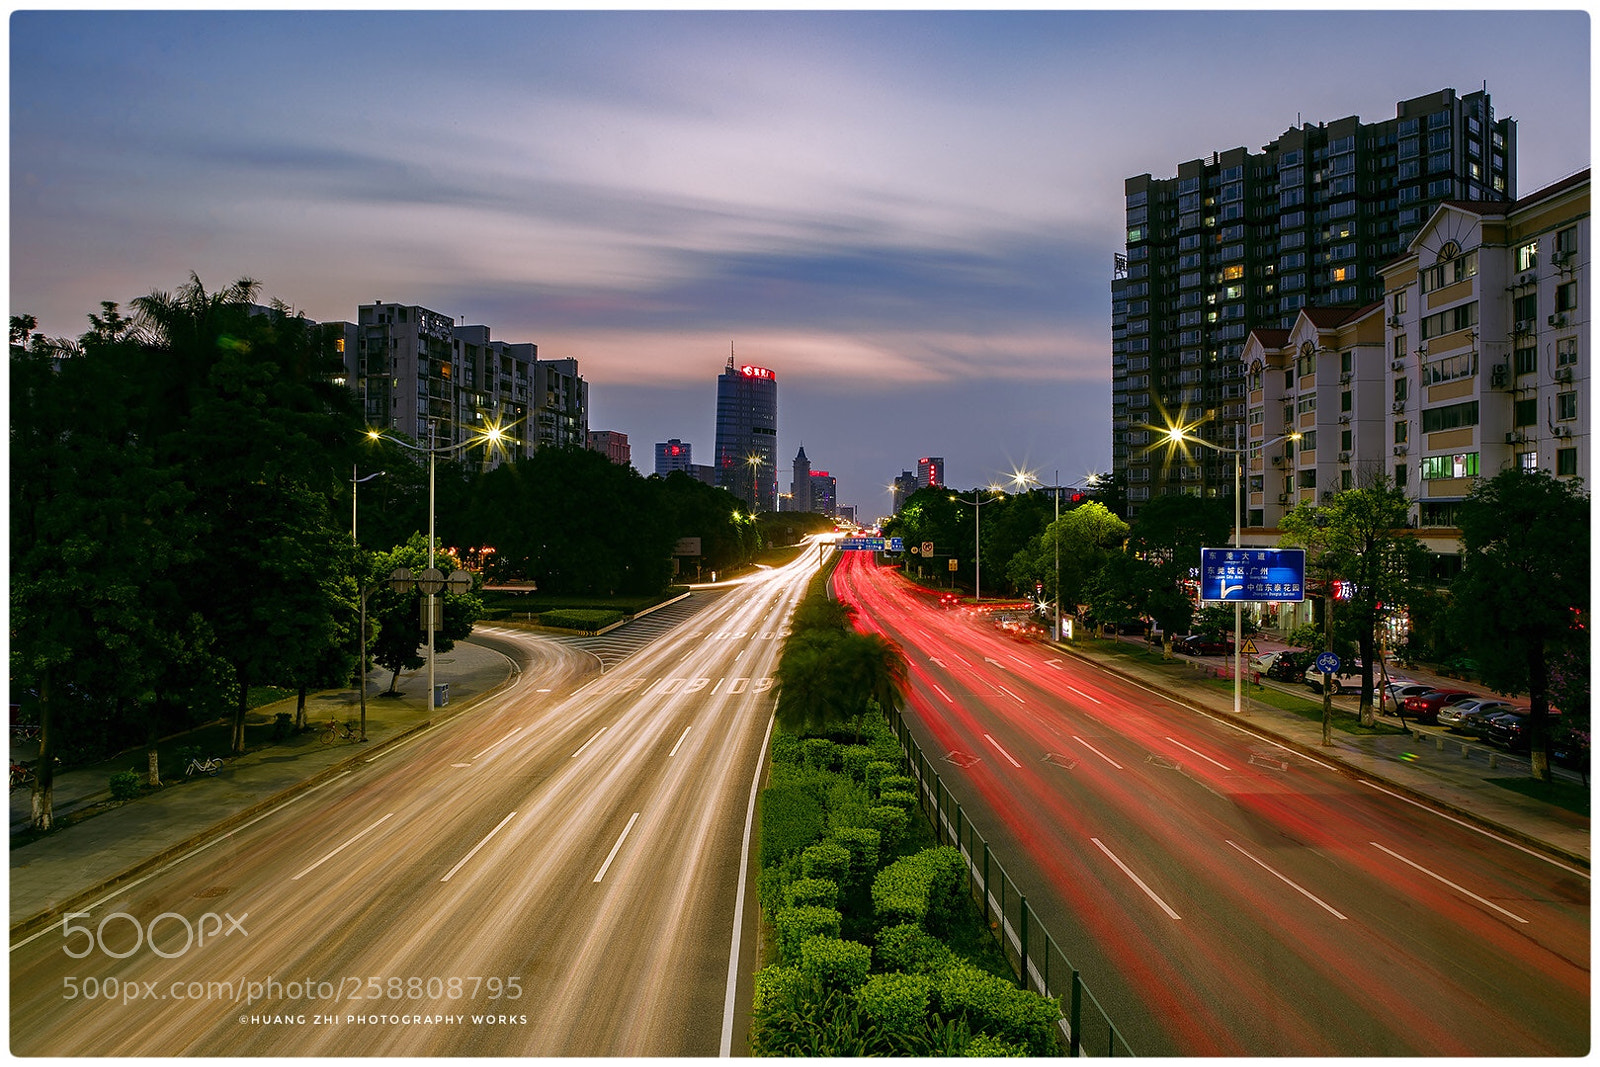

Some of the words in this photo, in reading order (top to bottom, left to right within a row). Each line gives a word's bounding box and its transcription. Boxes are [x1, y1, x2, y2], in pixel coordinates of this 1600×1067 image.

[1208, 552, 1265, 560] 东莞大道
[1247, 583, 1300, 592] 中信东泰花园
